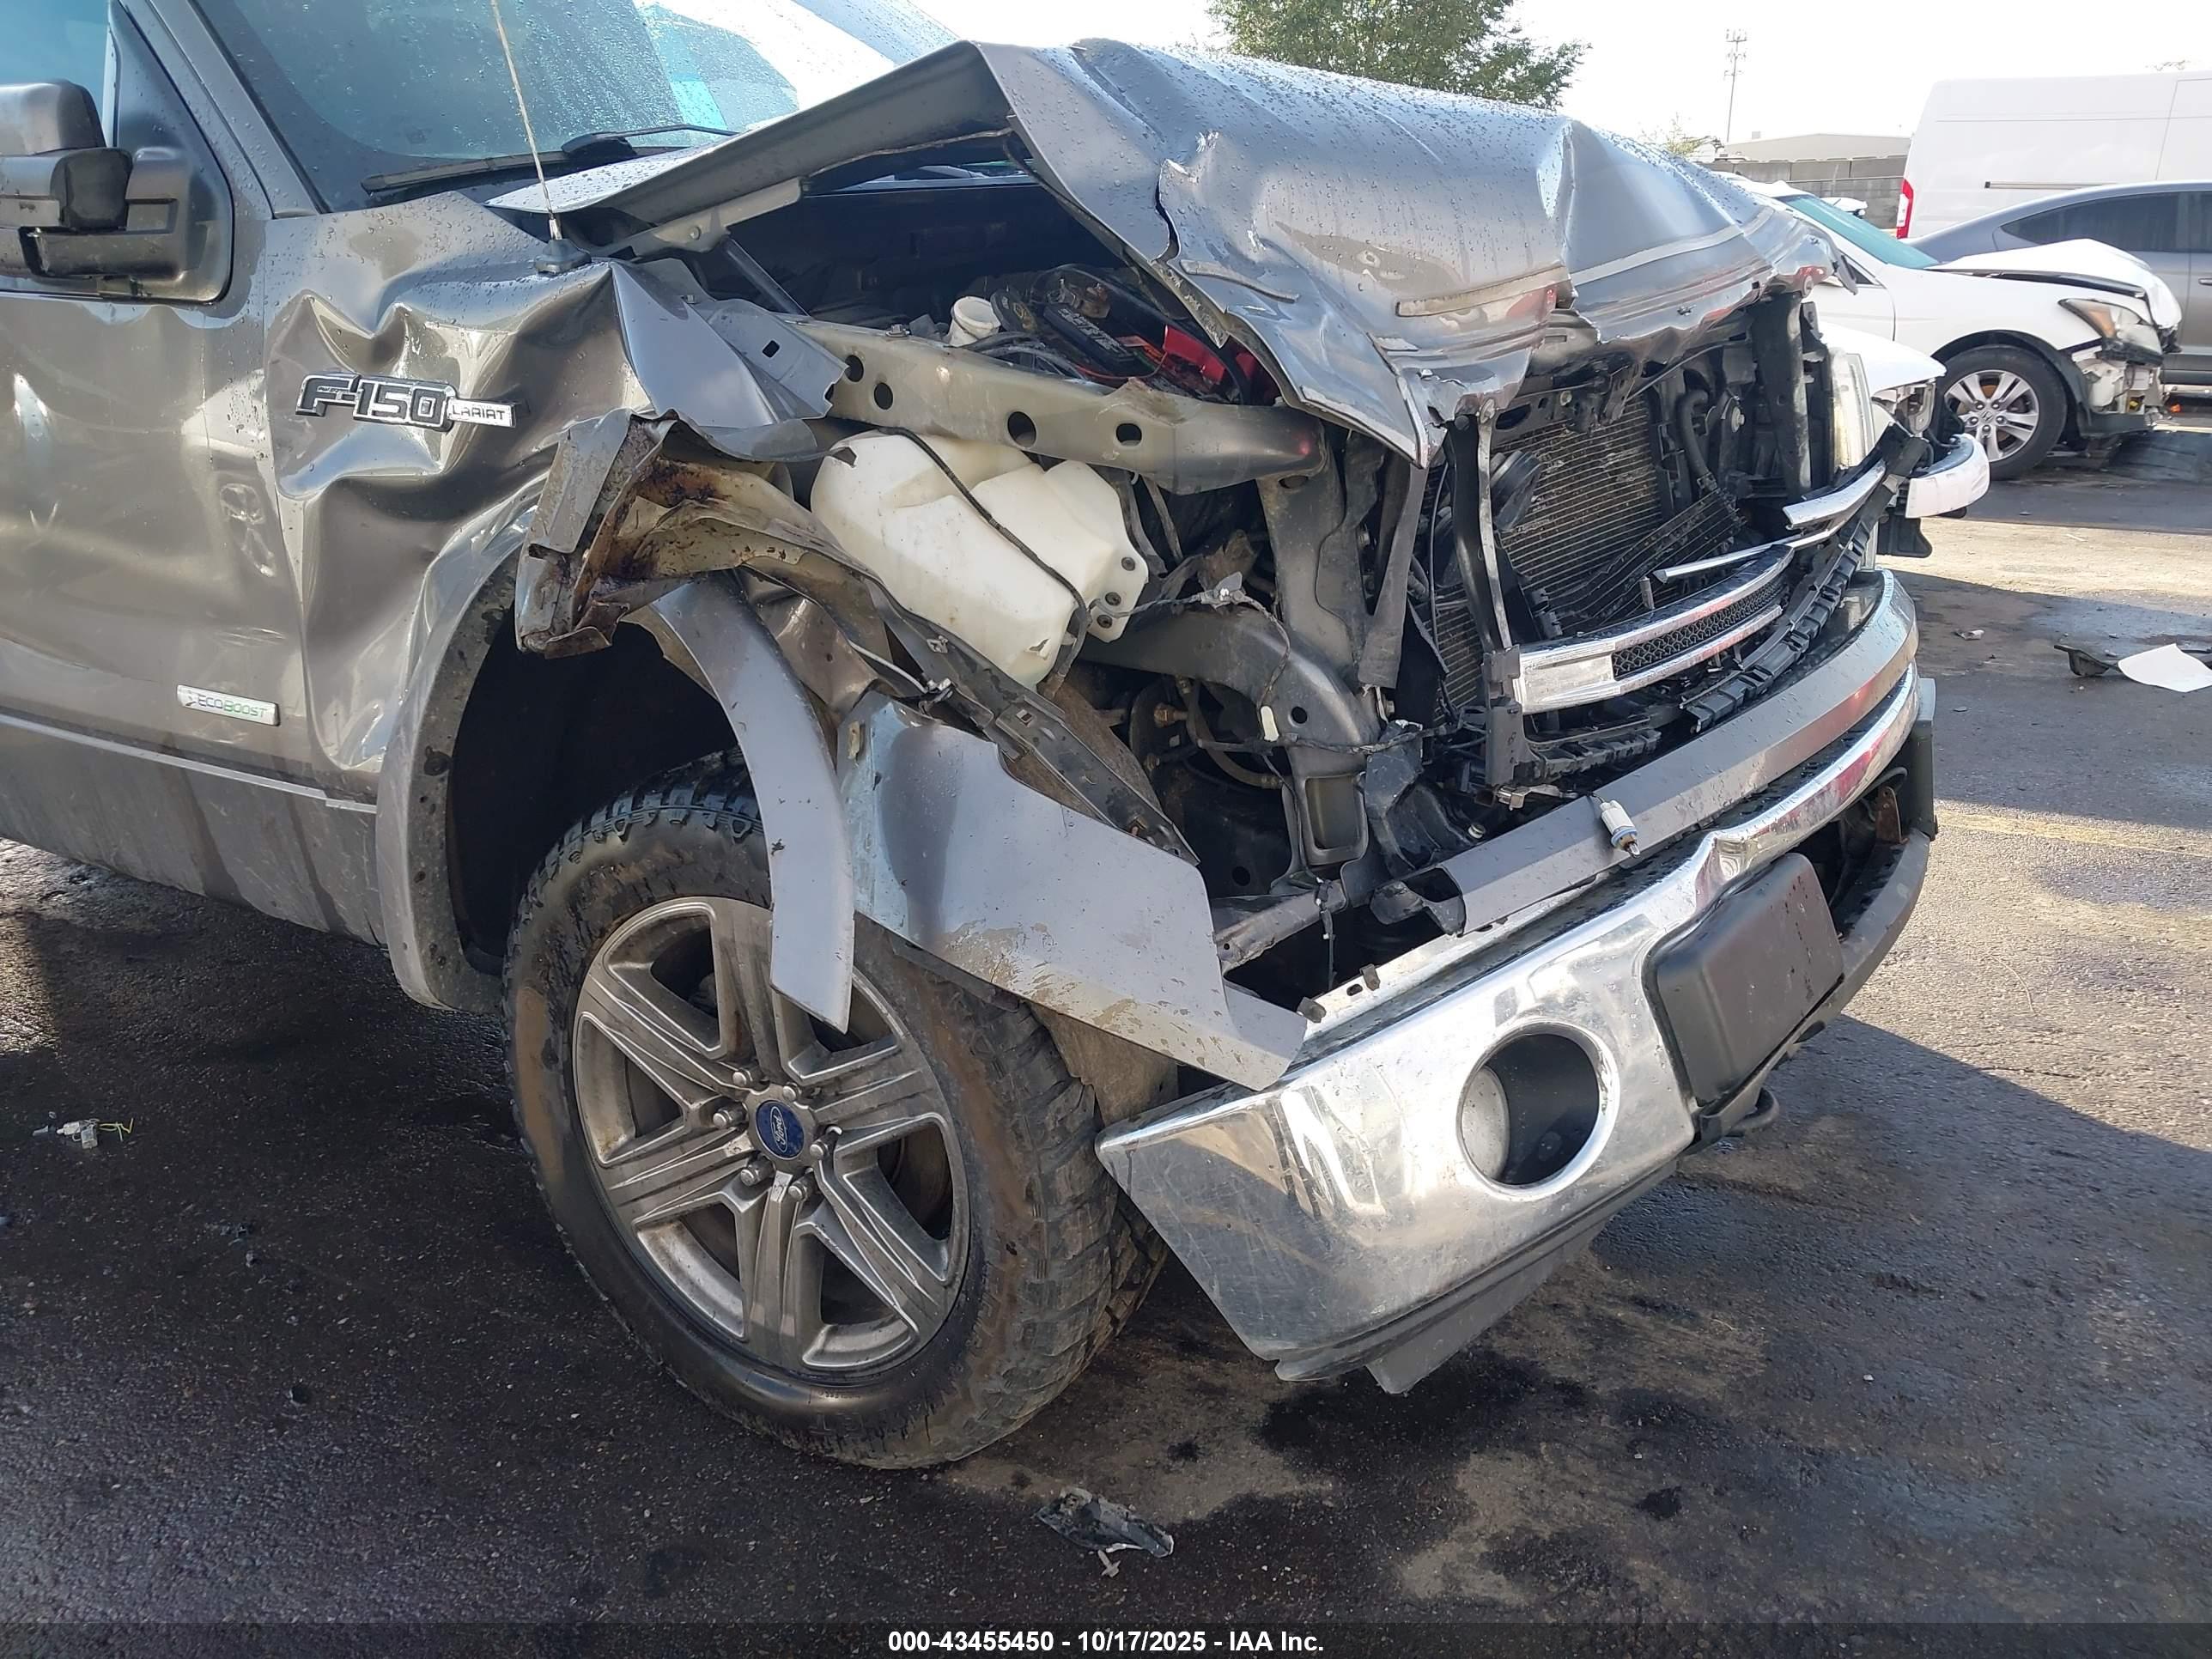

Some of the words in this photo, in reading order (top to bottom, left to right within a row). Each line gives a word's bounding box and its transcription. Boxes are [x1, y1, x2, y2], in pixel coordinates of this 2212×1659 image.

[296, 374, 455, 428] F-150
[451, 403, 507, 421] LARIAT
[198, 693, 268, 718] ECOBOOST
